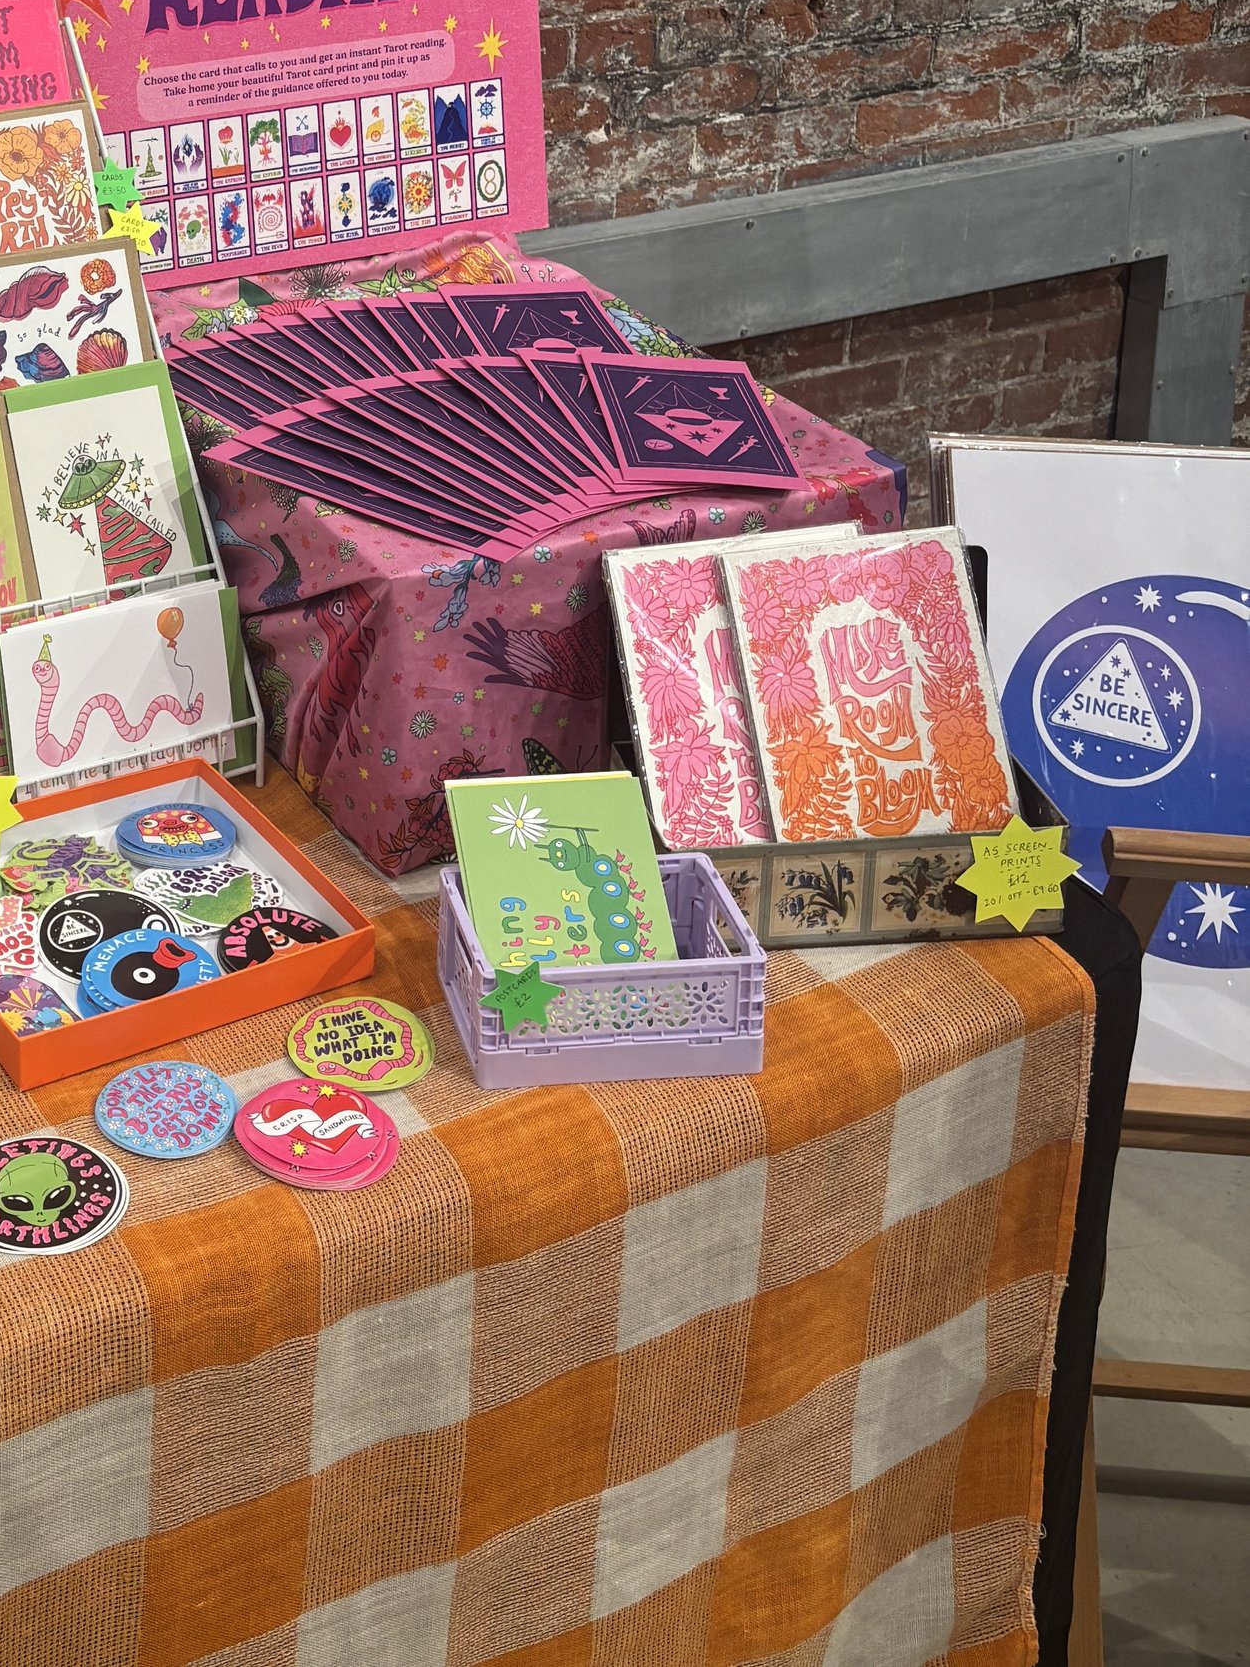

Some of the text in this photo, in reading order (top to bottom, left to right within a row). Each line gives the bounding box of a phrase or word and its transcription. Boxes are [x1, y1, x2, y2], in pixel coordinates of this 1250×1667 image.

[144, 38, 447, 86] Choose the card that calls to you and get an instant Tarot reading.
[163, 53, 431, 97] Take home your beautiful Tarot card print and pin it up as
[196, 93, 240, 106] reminder
[242, 89, 253, 99] of
[254, 87, 270, 98] the
[272, 82, 314, 98] guidance
[316, 76, 349, 89] offered
[351, 75, 361, 84] to
[363, 73, 379, 85] you
[382, 69, 409, 81] today.
[113, 488, 177, 542] THING CALLED
[819, 617, 912, 705] MAKE
[1100, 674, 1125, 696] BE
[836, 685, 922, 761] ROOM
[1072, 693, 1152, 728] SINCERE
[846, 746, 878, 777] TO
[855, 766, 943, 837] BLOOM
[150, 840, 225, 855] PRINCESS
[1000, 855, 1041, 867] PRINTS
[93, 931, 147, 972] MENACE
[224, 909, 322, 958] ABSOLUTE
[495, 969, 536, 1003] POSTCARDS
[317, 1021, 384, 1042] NO IDEA
[319, 1011, 366, 1029] I HAVE
[314, 1031, 396, 1057] WHAT I'M
[342, 1045, 394, 1064] DOING
[106, 1068, 174, 1118] DON'T LET
[127, 1083, 166, 1107] THE
[153, 1090, 208, 1138] GET YOU
[171, 1099, 222, 1148] DOWN
[273, 1114, 364, 1135] CRISP SANDWICHES
